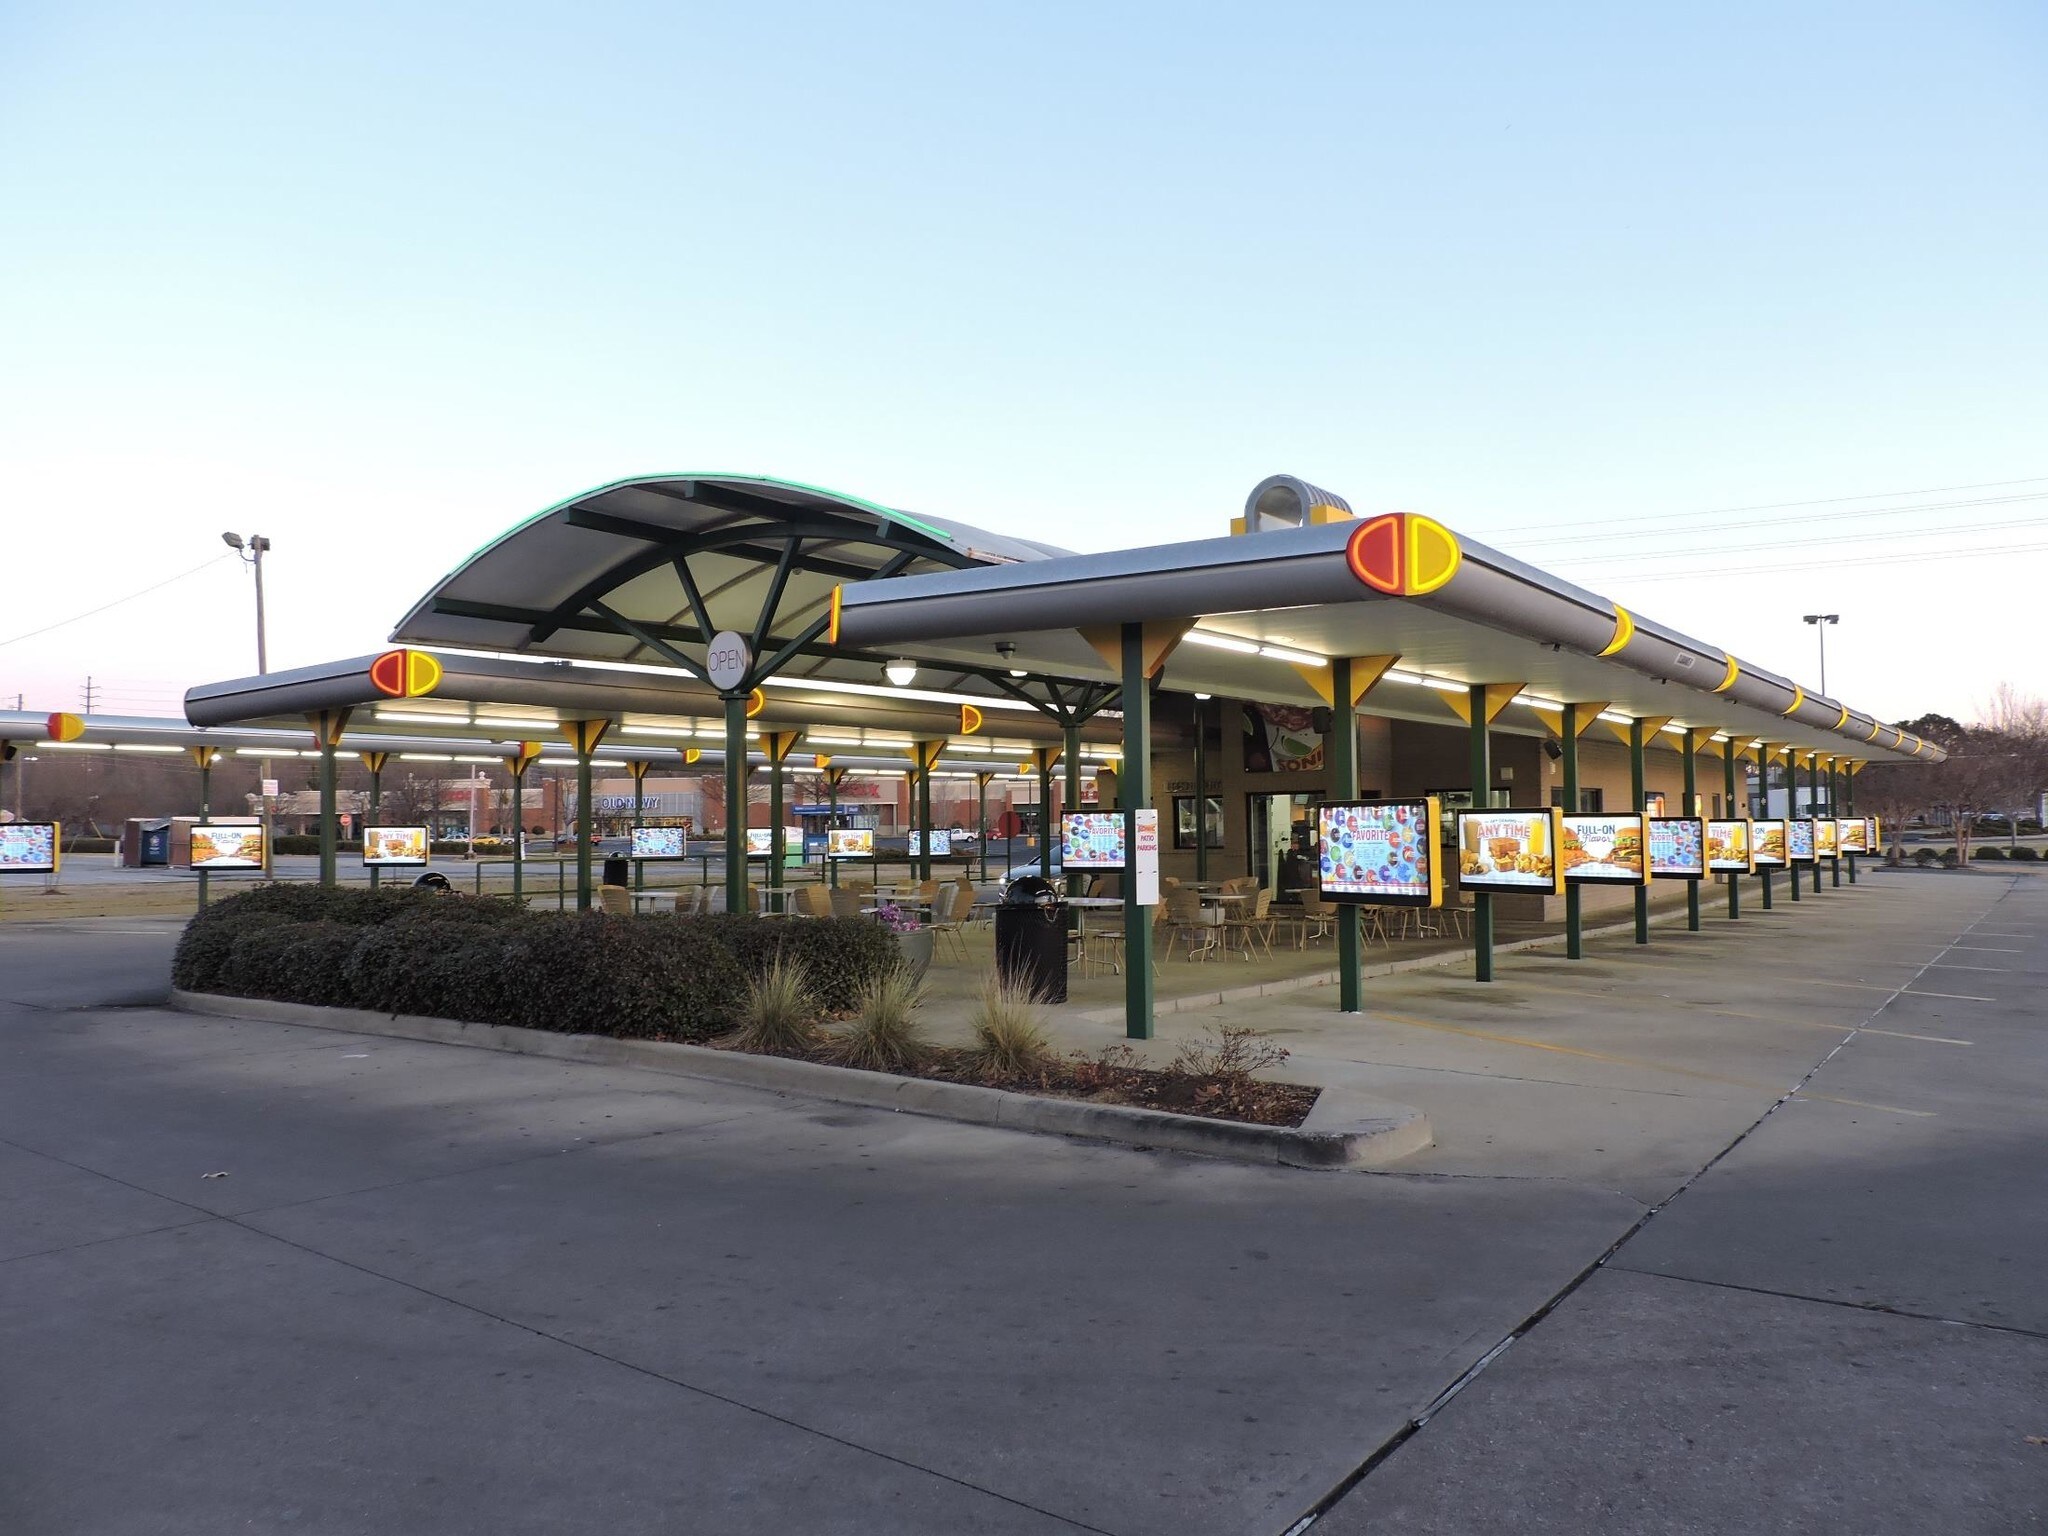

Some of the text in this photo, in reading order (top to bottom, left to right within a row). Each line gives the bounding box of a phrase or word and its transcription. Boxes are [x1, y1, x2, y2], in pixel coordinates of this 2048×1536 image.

[709, 649, 745, 671] OPEN
[602, 797, 659, 809] OLD NVY
[1353, 829, 1389, 841] FAVORITE
[1477, 823, 1531, 838] ANY TIME
[1577, 825, 1615, 834] FULL-ON
